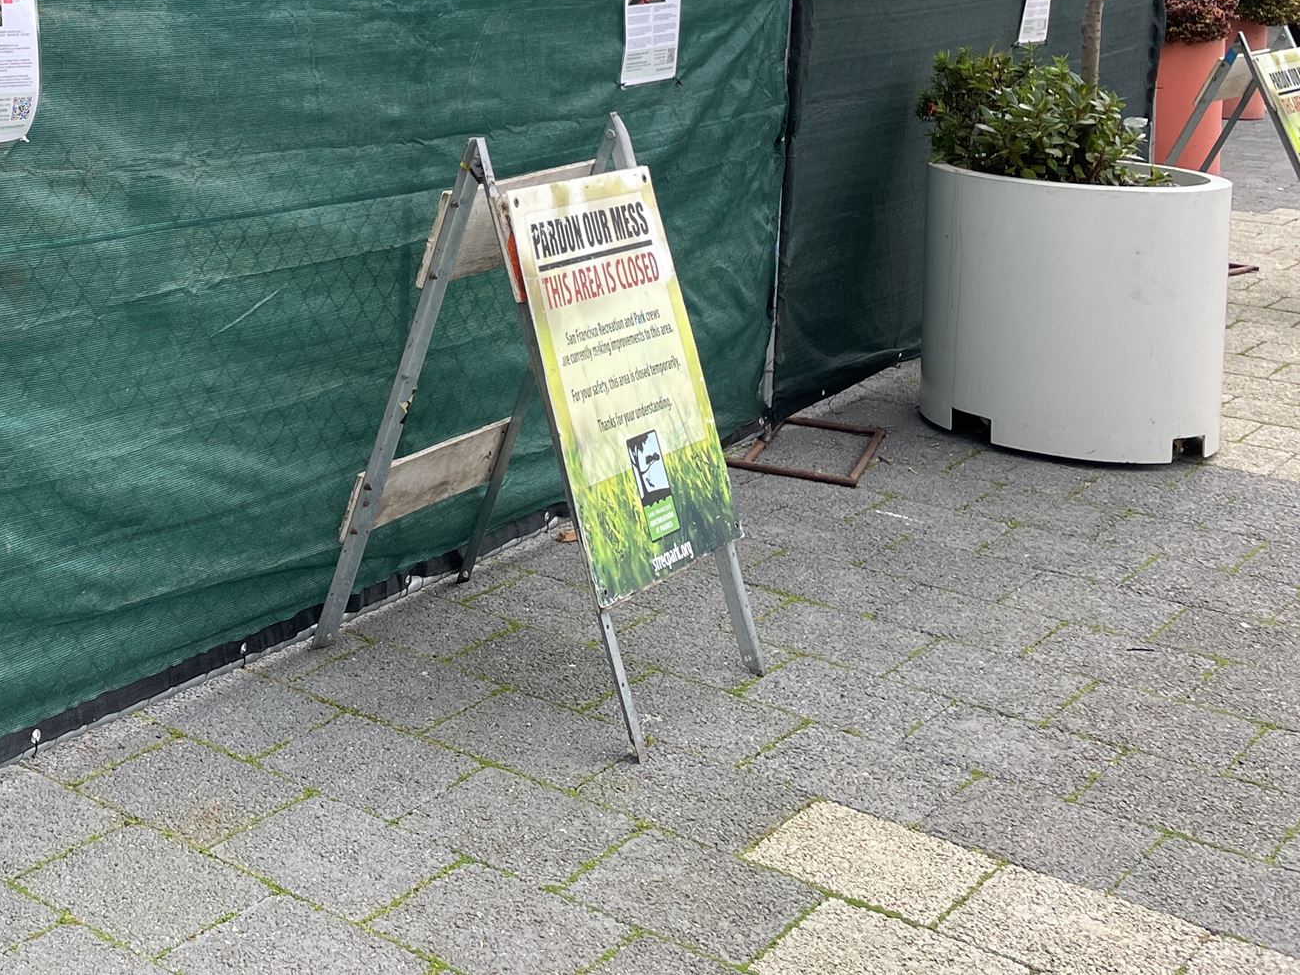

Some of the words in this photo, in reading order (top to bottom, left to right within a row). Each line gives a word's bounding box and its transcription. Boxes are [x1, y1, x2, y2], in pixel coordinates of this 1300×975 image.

[530, 215, 585, 259] PARDON
[582, 209, 612, 247] OUR
[609, 201, 649, 241] MESS
[542, 272, 572, 310] THIS
[572, 265, 604, 303] AREA
[601, 261, 617, 293] IS
[616, 251, 659, 289] CLOSED
[565, 332, 576, 345] San
[575, 325, 599, 343] Francisco
[598, 318, 624, 336] Recreation
[624, 313, 635, 327] and
[634, 310, 646, 326] Park
[645, 309, 660, 321] crews
[570, 345, 593, 365] currently
[592, 340, 612, 357] making
[609, 330, 646, 353] improvements
[644, 329, 650, 341] to
[650, 324, 661, 339] this
[660, 323, 674, 335] area.
[571, 389, 580, 403] For
[580, 389, 592, 404] your
[592, 380, 610, 395] safety,
[608, 375, 620, 389] this
[618, 373, 630, 386] area
[629, 369, 635, 383] is
[634, 366, 650, 381] closed
[650, 355, 680, 378] temporarily.
[597, 413, 617, 433] Thanks
[615, 411, 624, 425] for
[624, 409, 636, 427] your
[635, 397, 672, 419] understanding.
[652, 541, 694, 571] sfrecpark.org
